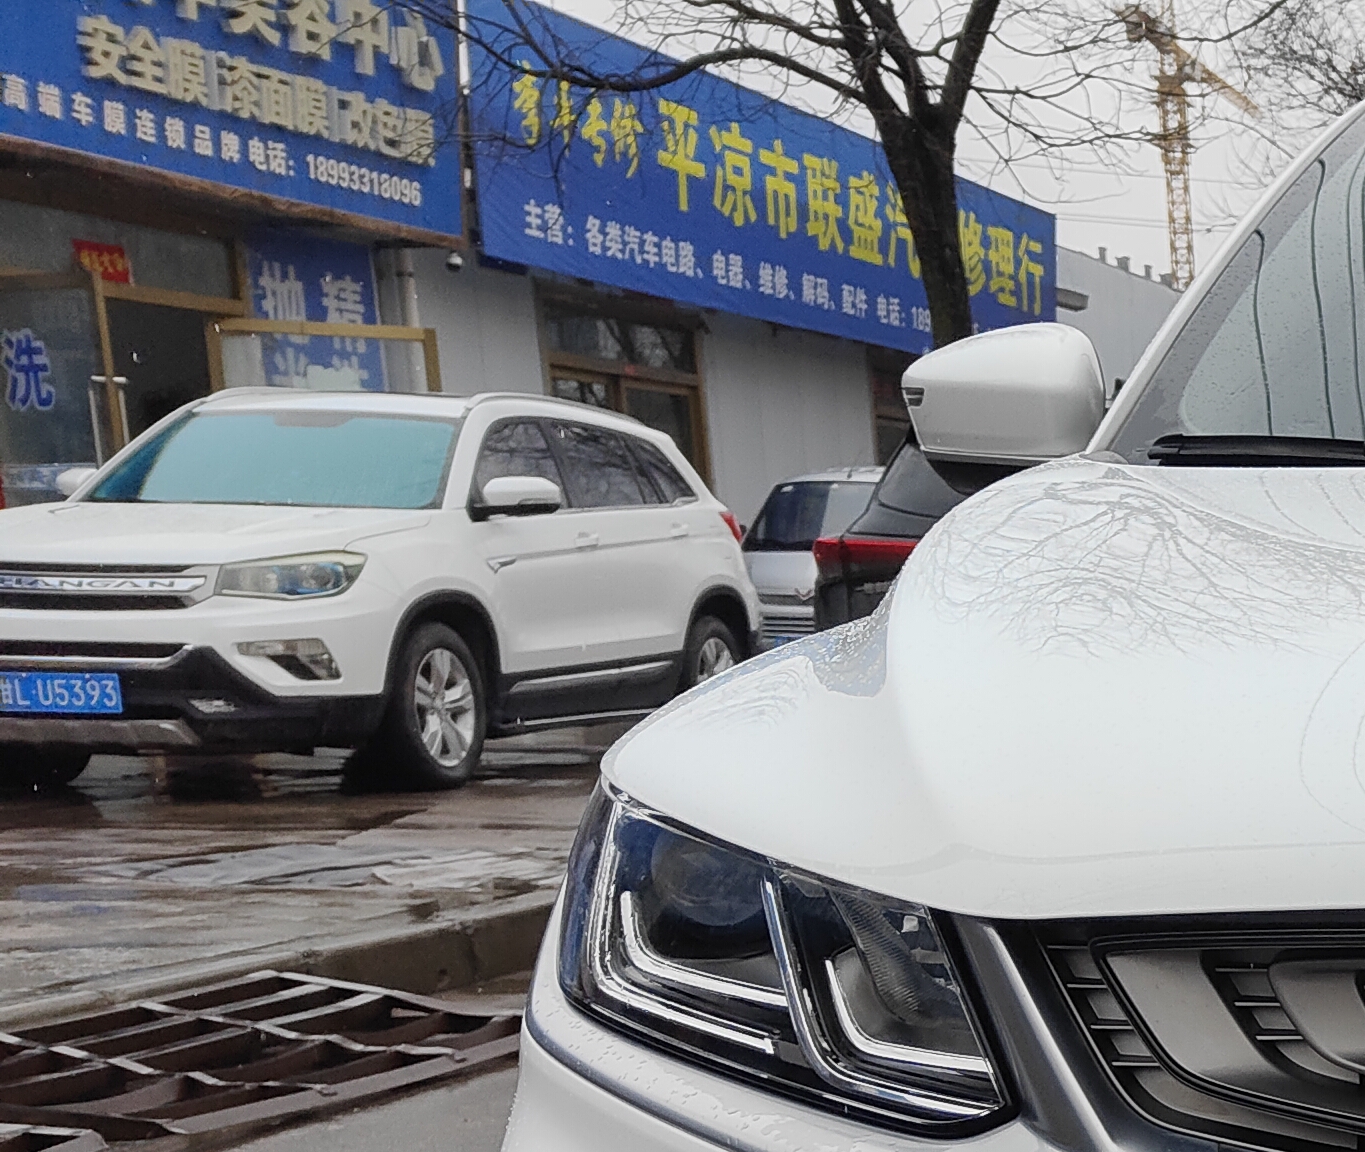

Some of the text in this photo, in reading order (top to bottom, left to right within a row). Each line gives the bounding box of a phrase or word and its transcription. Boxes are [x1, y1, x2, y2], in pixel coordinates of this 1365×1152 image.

[658, 98, 1044, 317] 平凉市联盛汽修理行
[1, 328, 55, 411] 洗
